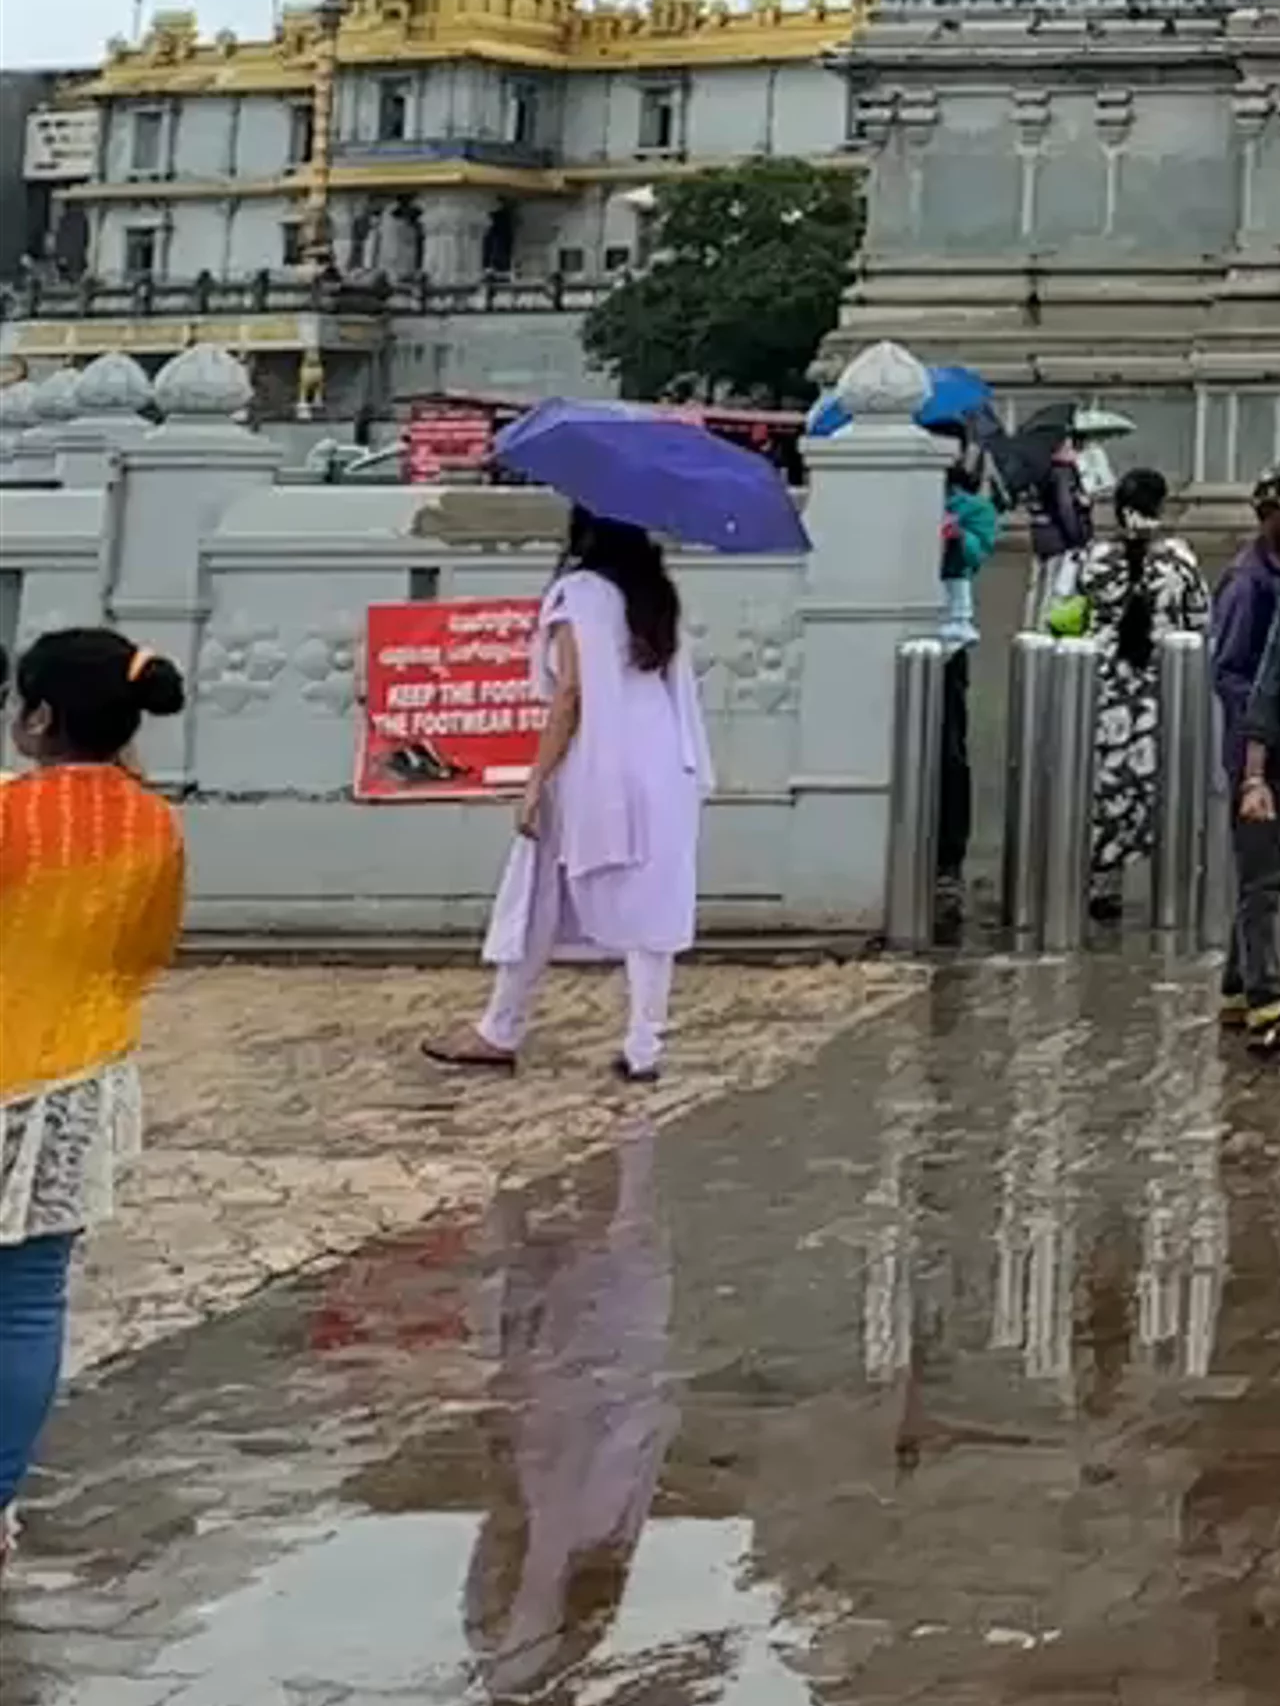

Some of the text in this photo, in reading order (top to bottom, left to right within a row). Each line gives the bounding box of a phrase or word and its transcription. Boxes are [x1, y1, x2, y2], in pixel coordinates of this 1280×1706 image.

[387, 683, 436, 708] KEEP
[438, 680, 476, 705] THE
[372, 713, 408, 737] THE
[411, 708, 513, 735] FOOTWEAR
